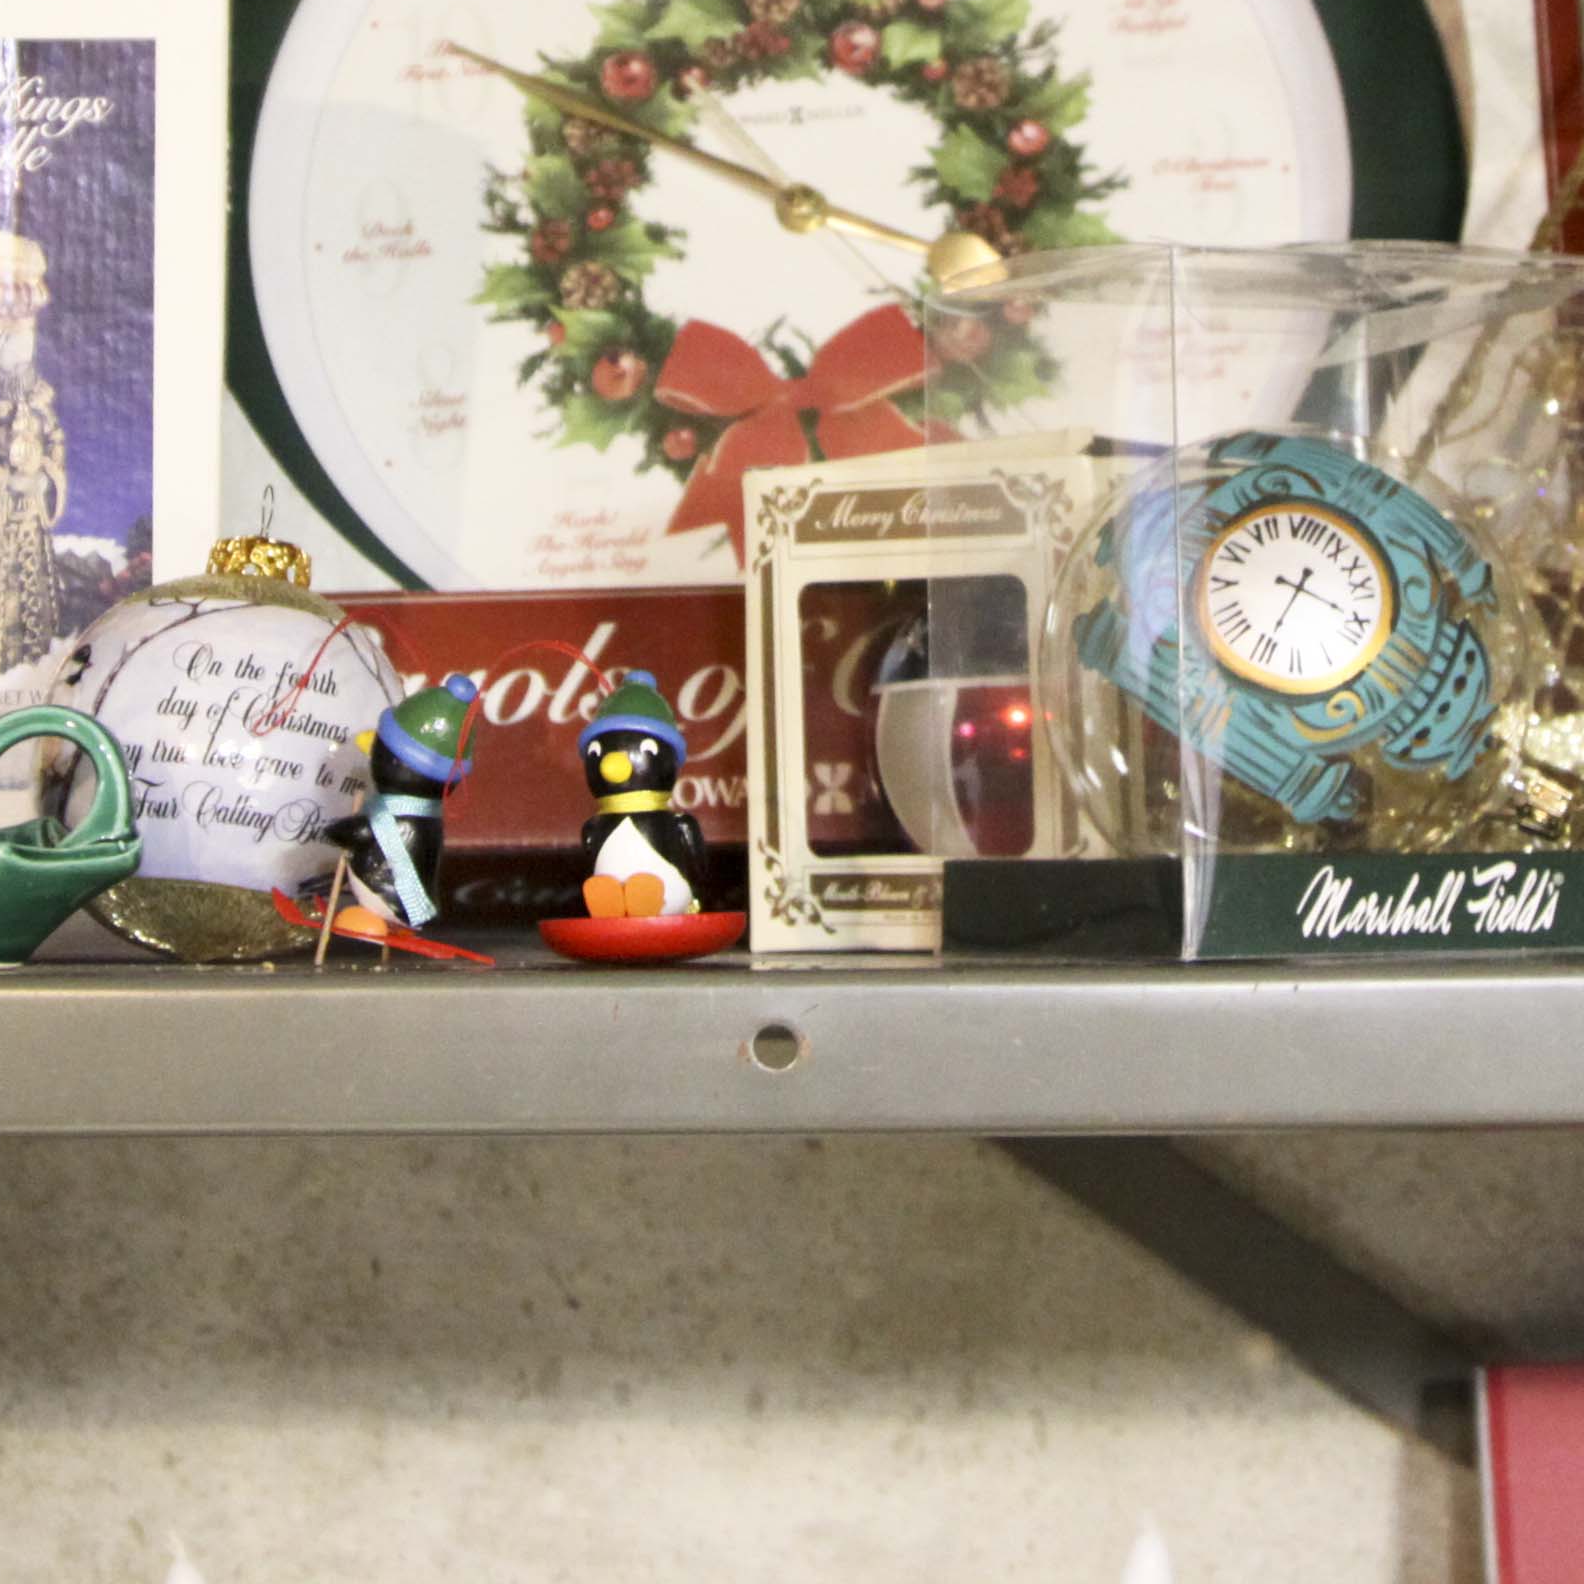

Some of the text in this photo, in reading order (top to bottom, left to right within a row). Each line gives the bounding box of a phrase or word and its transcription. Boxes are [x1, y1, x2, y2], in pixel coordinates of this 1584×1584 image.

[815, 494, 894, 537] Merry
[173, 641, 223, 681] On
[235, 653, 266, 680] the
[156, 686, 350, 743] day of Christmas
[202, 732, 244, 766] love
[255, 755, 303, 783] gave
[315, 762, 333, 789] to
[134, 777, 180, 820] Four
[182, 780, 276, 843] Calling
[1296, 861, 1563, 938] Marshall Field's
